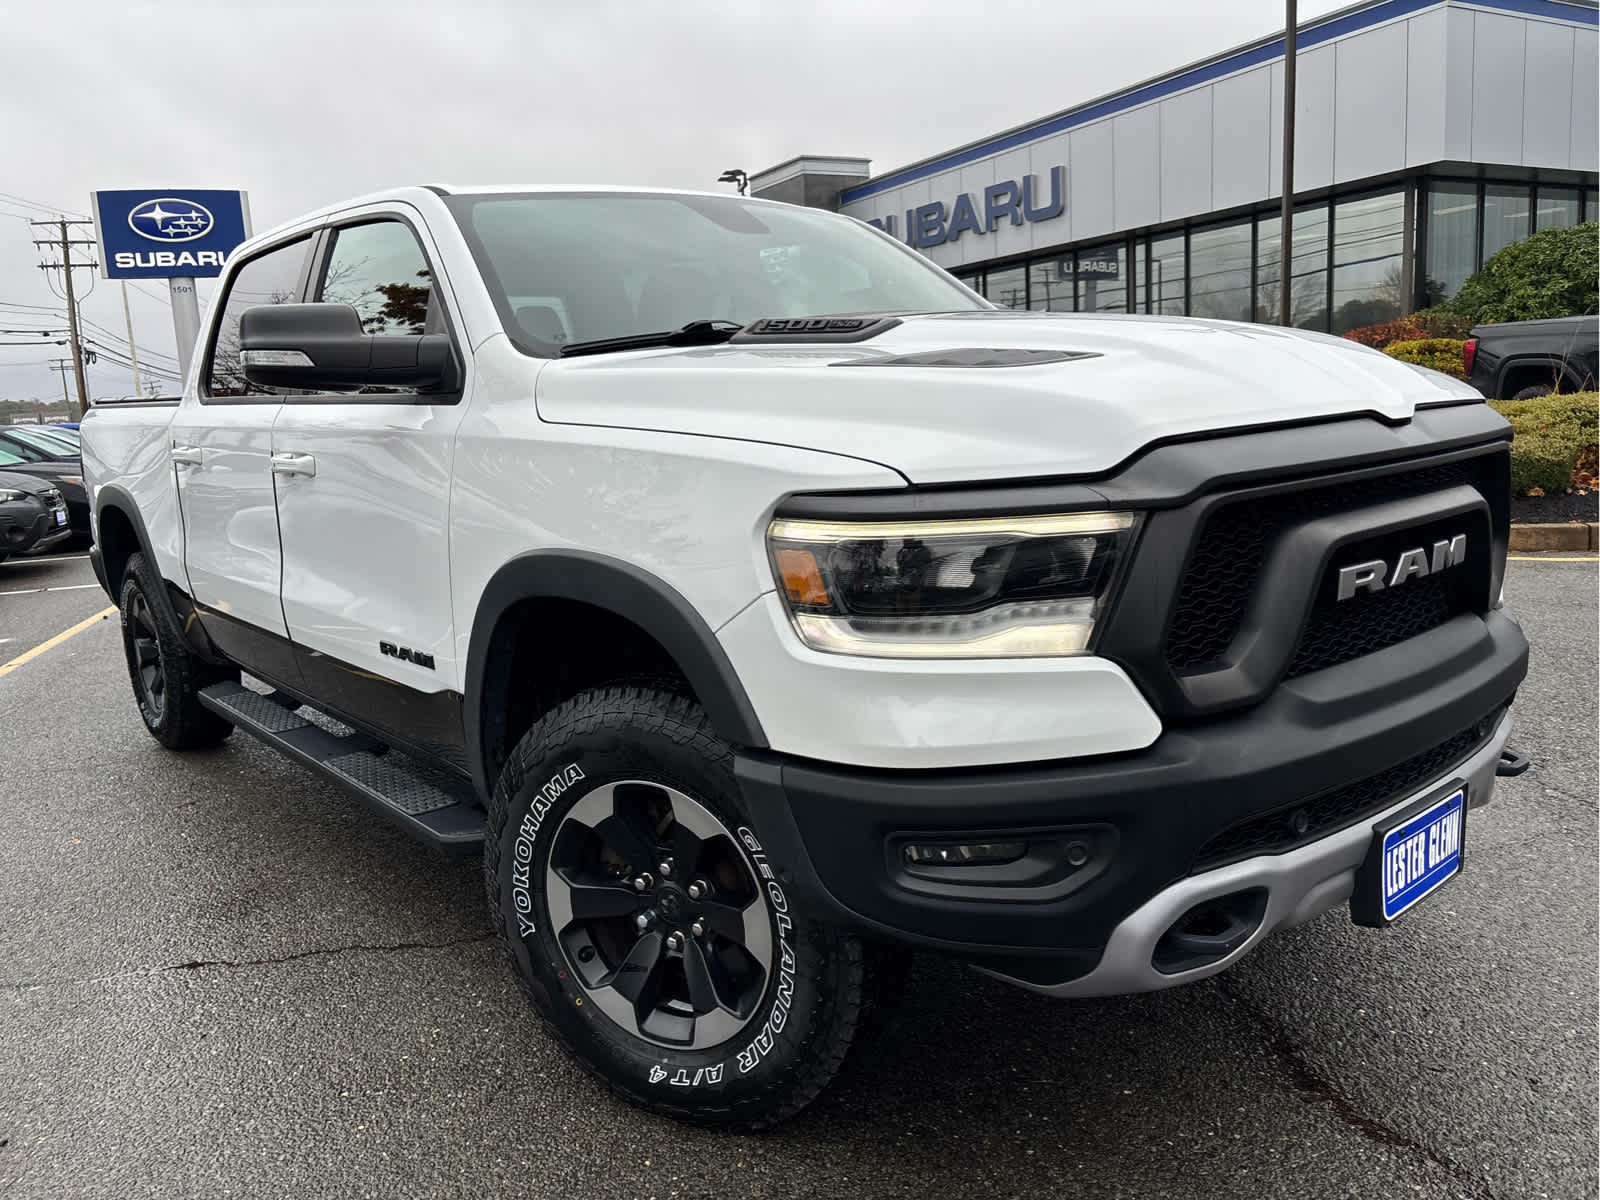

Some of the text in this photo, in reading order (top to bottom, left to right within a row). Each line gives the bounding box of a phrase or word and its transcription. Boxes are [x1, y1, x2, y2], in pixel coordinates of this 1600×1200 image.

[868, 165, 1065, 250] UBARU
[172, 286, 193, 294] 1501
[1337, 533, 1466, 601] RAM
[379, 640, 436, 670] RAM
[512, 763, 586, 938] YOKOHAMA
[1386, 808, 1460, 898] LESTER GLENN
[648, 826, 797, 1086] GEOLANDAR A/T4
